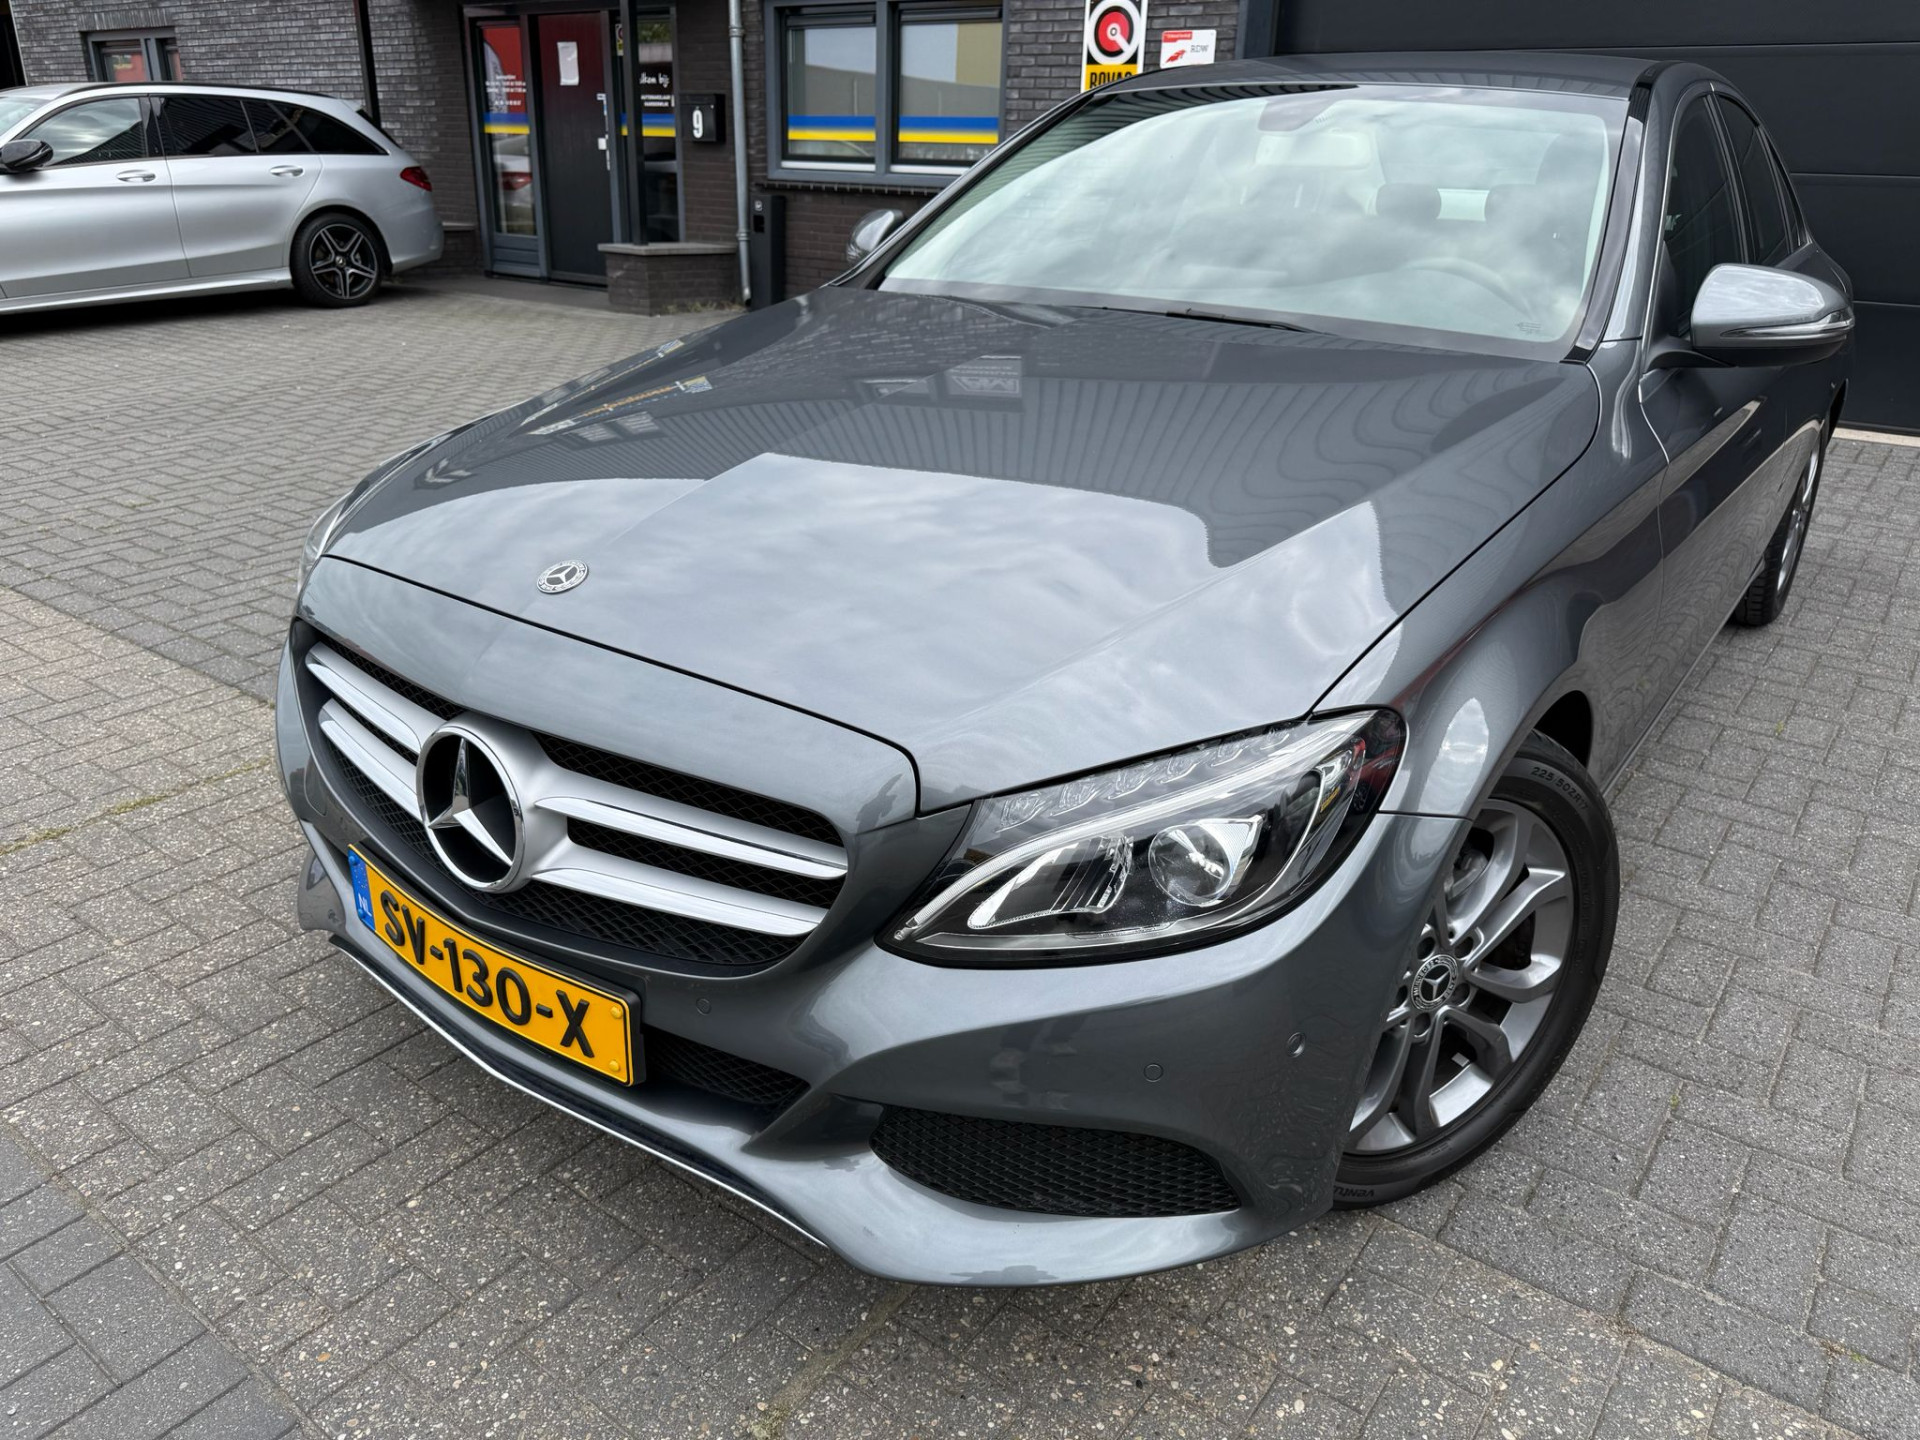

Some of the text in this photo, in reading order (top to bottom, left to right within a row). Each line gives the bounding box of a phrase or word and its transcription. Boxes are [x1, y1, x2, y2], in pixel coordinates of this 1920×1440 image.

[692, 109, 703, 139] 9
[357, 892, 373, 917] NL
[380, 888, 595, 1059] SV-130-X
